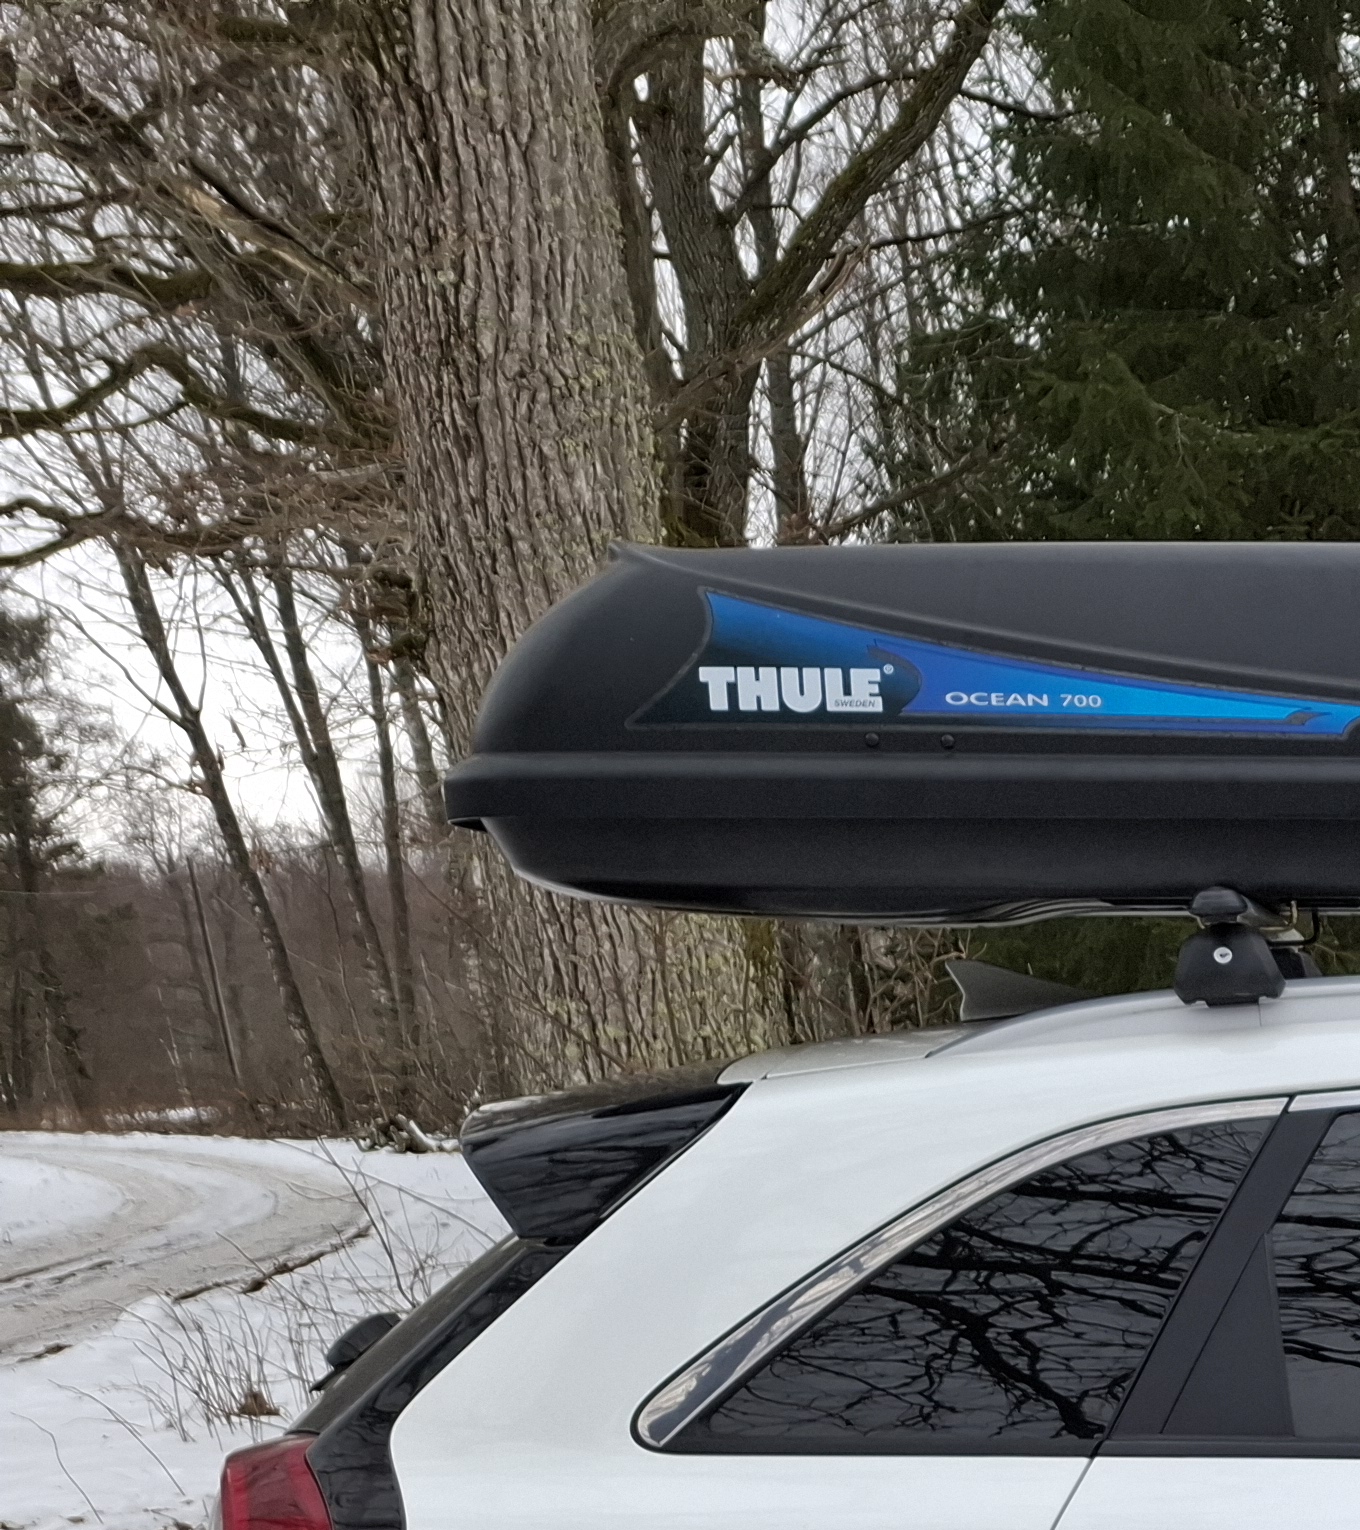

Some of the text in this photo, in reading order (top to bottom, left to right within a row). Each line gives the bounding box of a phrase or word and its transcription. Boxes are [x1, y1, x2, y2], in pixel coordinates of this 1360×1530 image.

[698, 666, 883, 713] THULE
[834, 698, 876, 708] SWEDEN
[945, 691, 1102, 708] OCEAN 700
